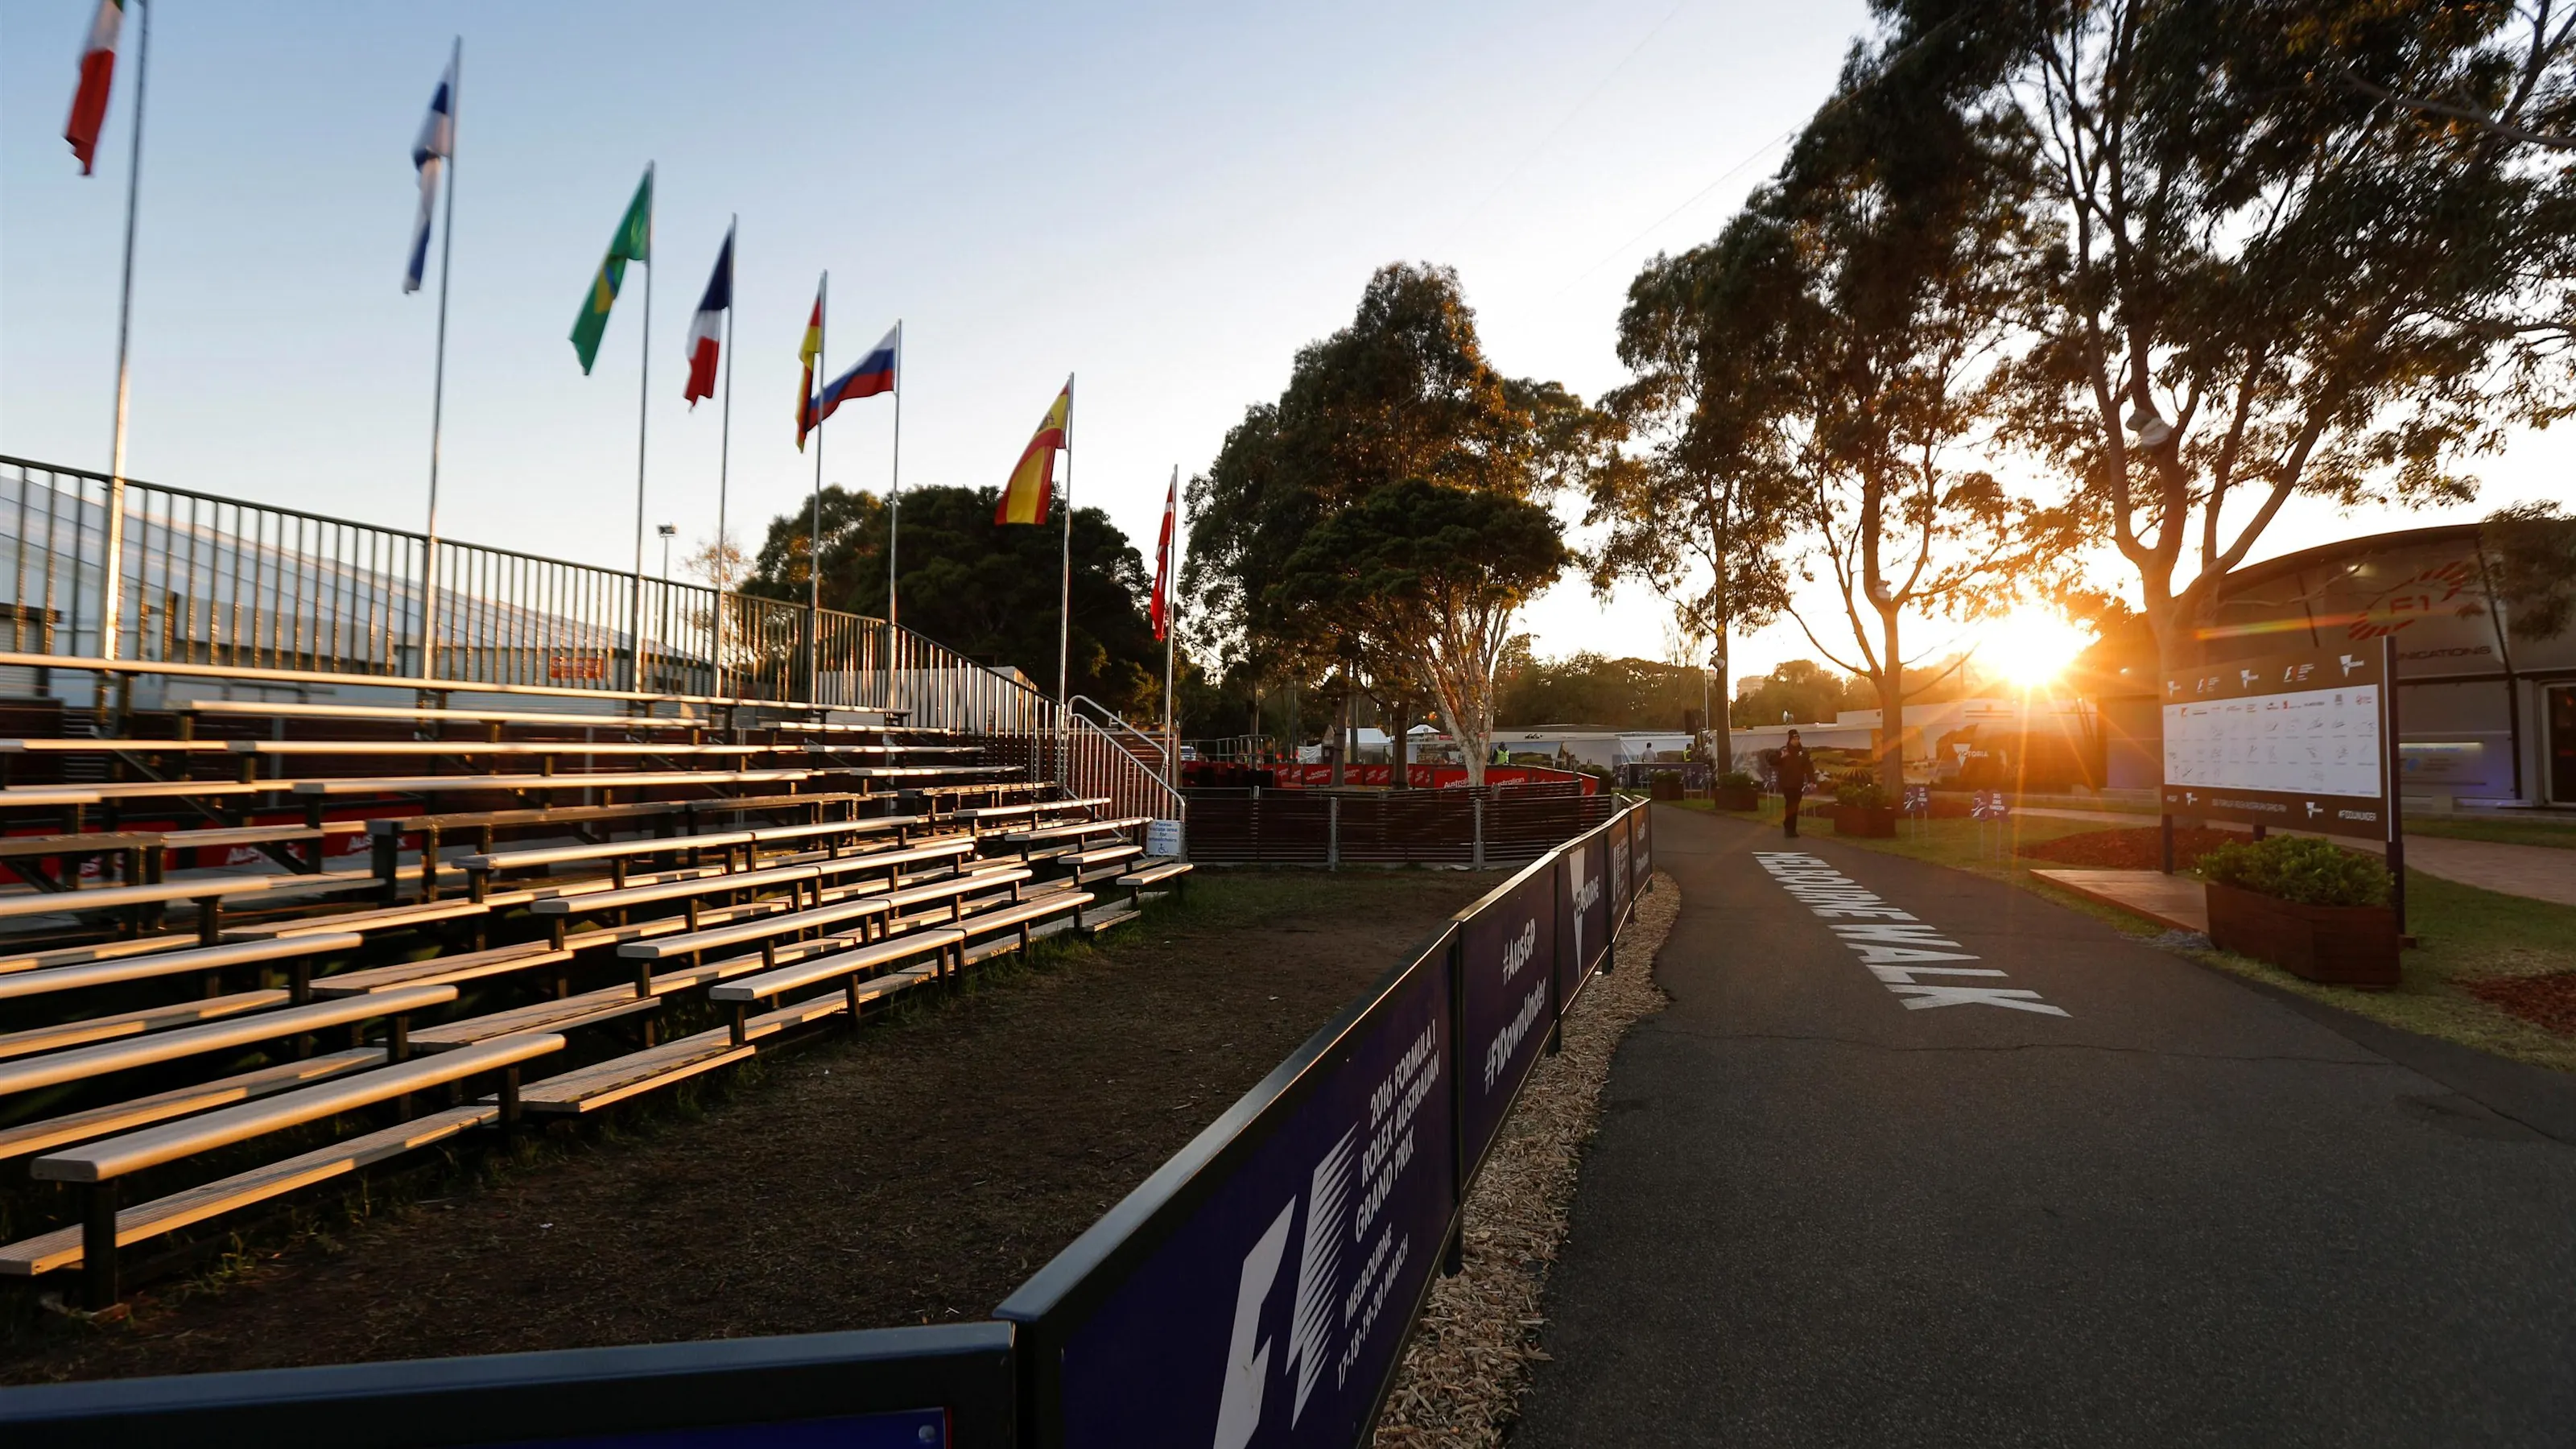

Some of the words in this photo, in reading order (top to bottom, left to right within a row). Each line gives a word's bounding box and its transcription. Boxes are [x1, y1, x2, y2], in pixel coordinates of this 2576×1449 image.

[2390, 595, 2429, 615] F1
[1752, 852, 1920, 921] MELBOURNE
[1502, 918, 1536, 987] #AusGP
[1827, 924, 2074, 1018] WALK
[1370, 1074, 1393, 1130] 2016
[1394, 1026, 1432, 1096] FORMULA
[1484, 976, 1547, 1096] #F1DownUnder
[1361, 1114, 1393, 1189] ROLEX
[1394, 1049, 1440, 1140] AUSTRALIAN
[1355, 1161, 1393, 1244] GRAND
[1394, 1124, 1415, 1181] PRIX
[1344, 1222, 1393, 1330] MELBOURNE
[1384, 1232, 1409, 1299] MARCH
